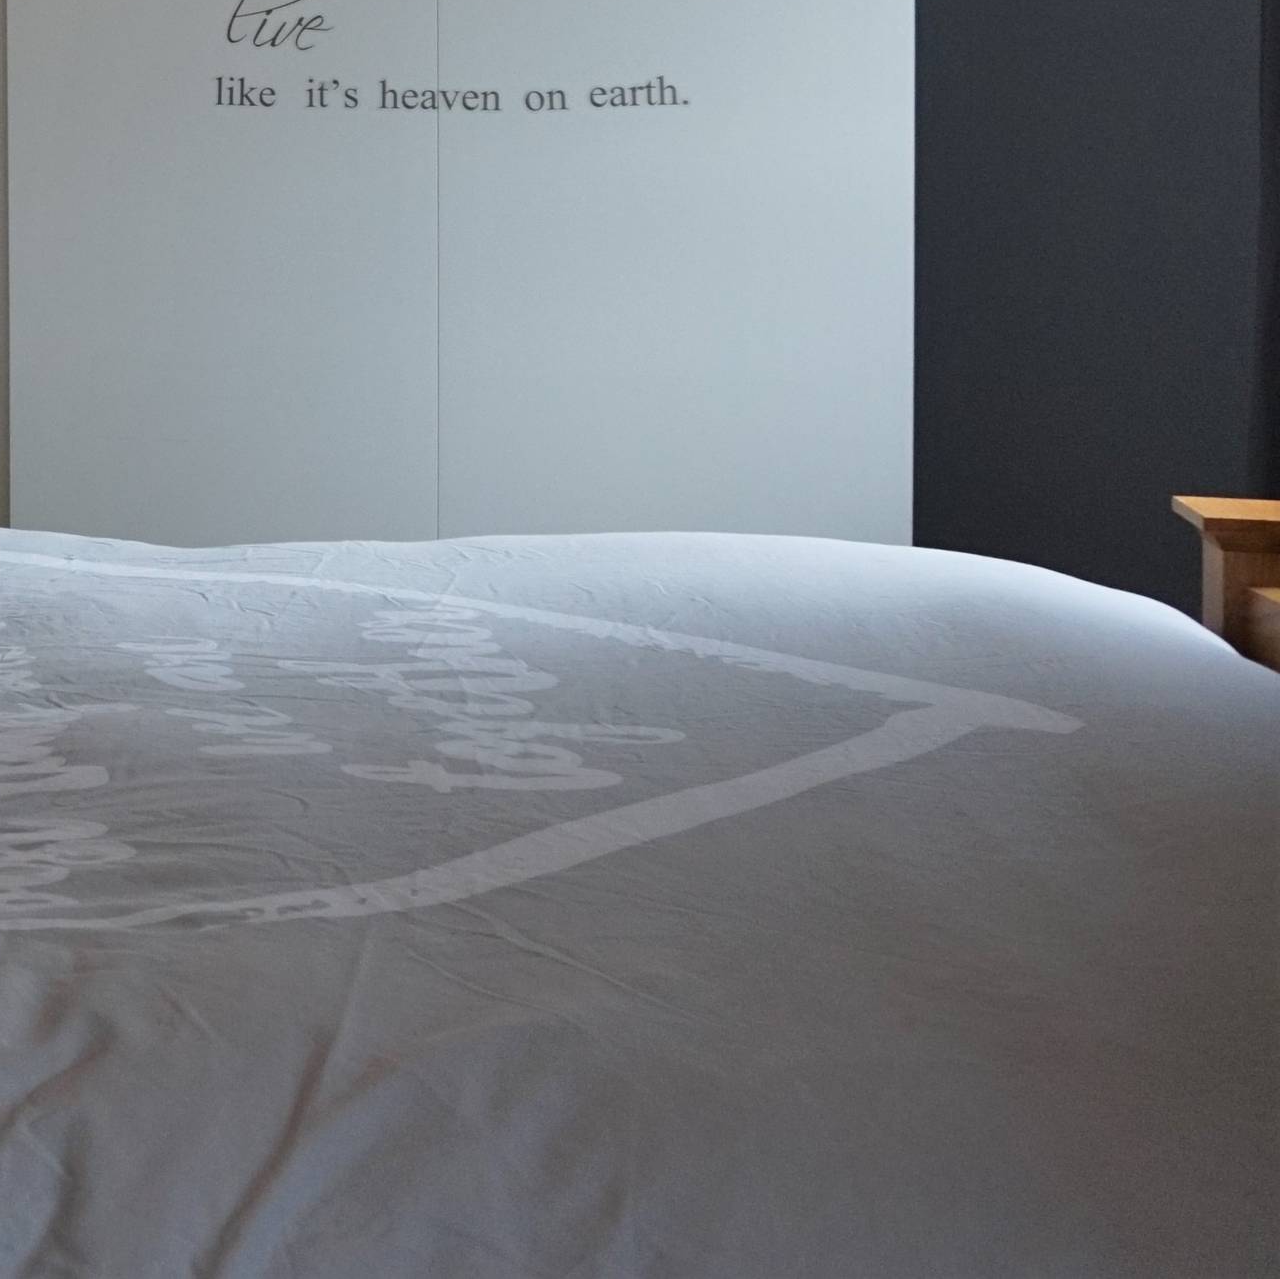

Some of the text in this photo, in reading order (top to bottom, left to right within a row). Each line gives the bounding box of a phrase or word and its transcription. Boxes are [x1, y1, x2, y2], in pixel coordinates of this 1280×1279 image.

[214, 75, 690, 111] like it's heaven on earth.
